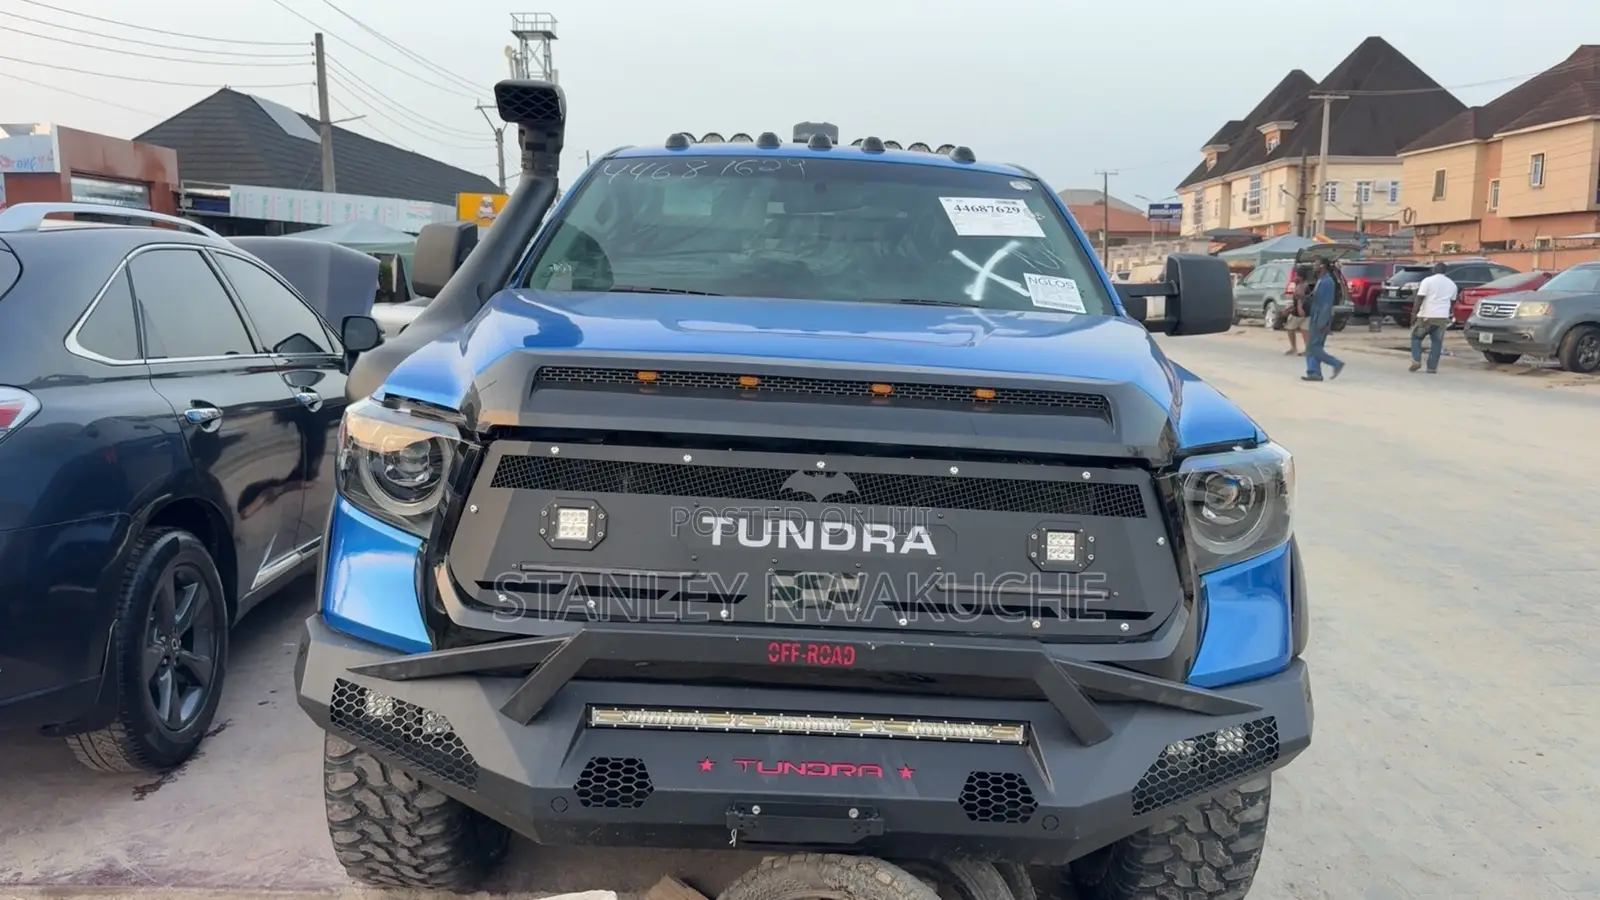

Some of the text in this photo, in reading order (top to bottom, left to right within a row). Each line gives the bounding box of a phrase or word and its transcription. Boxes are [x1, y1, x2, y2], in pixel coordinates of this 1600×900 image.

[953, 203, 1021, 215] 44687629
[1027, 275, 1076, 290] NGLOS
[702, 516, 938, 556] TUNDRA
[767, 641, 856, 666] OFF-ROAD
[732, 758, 884, 779] TUNDRA
